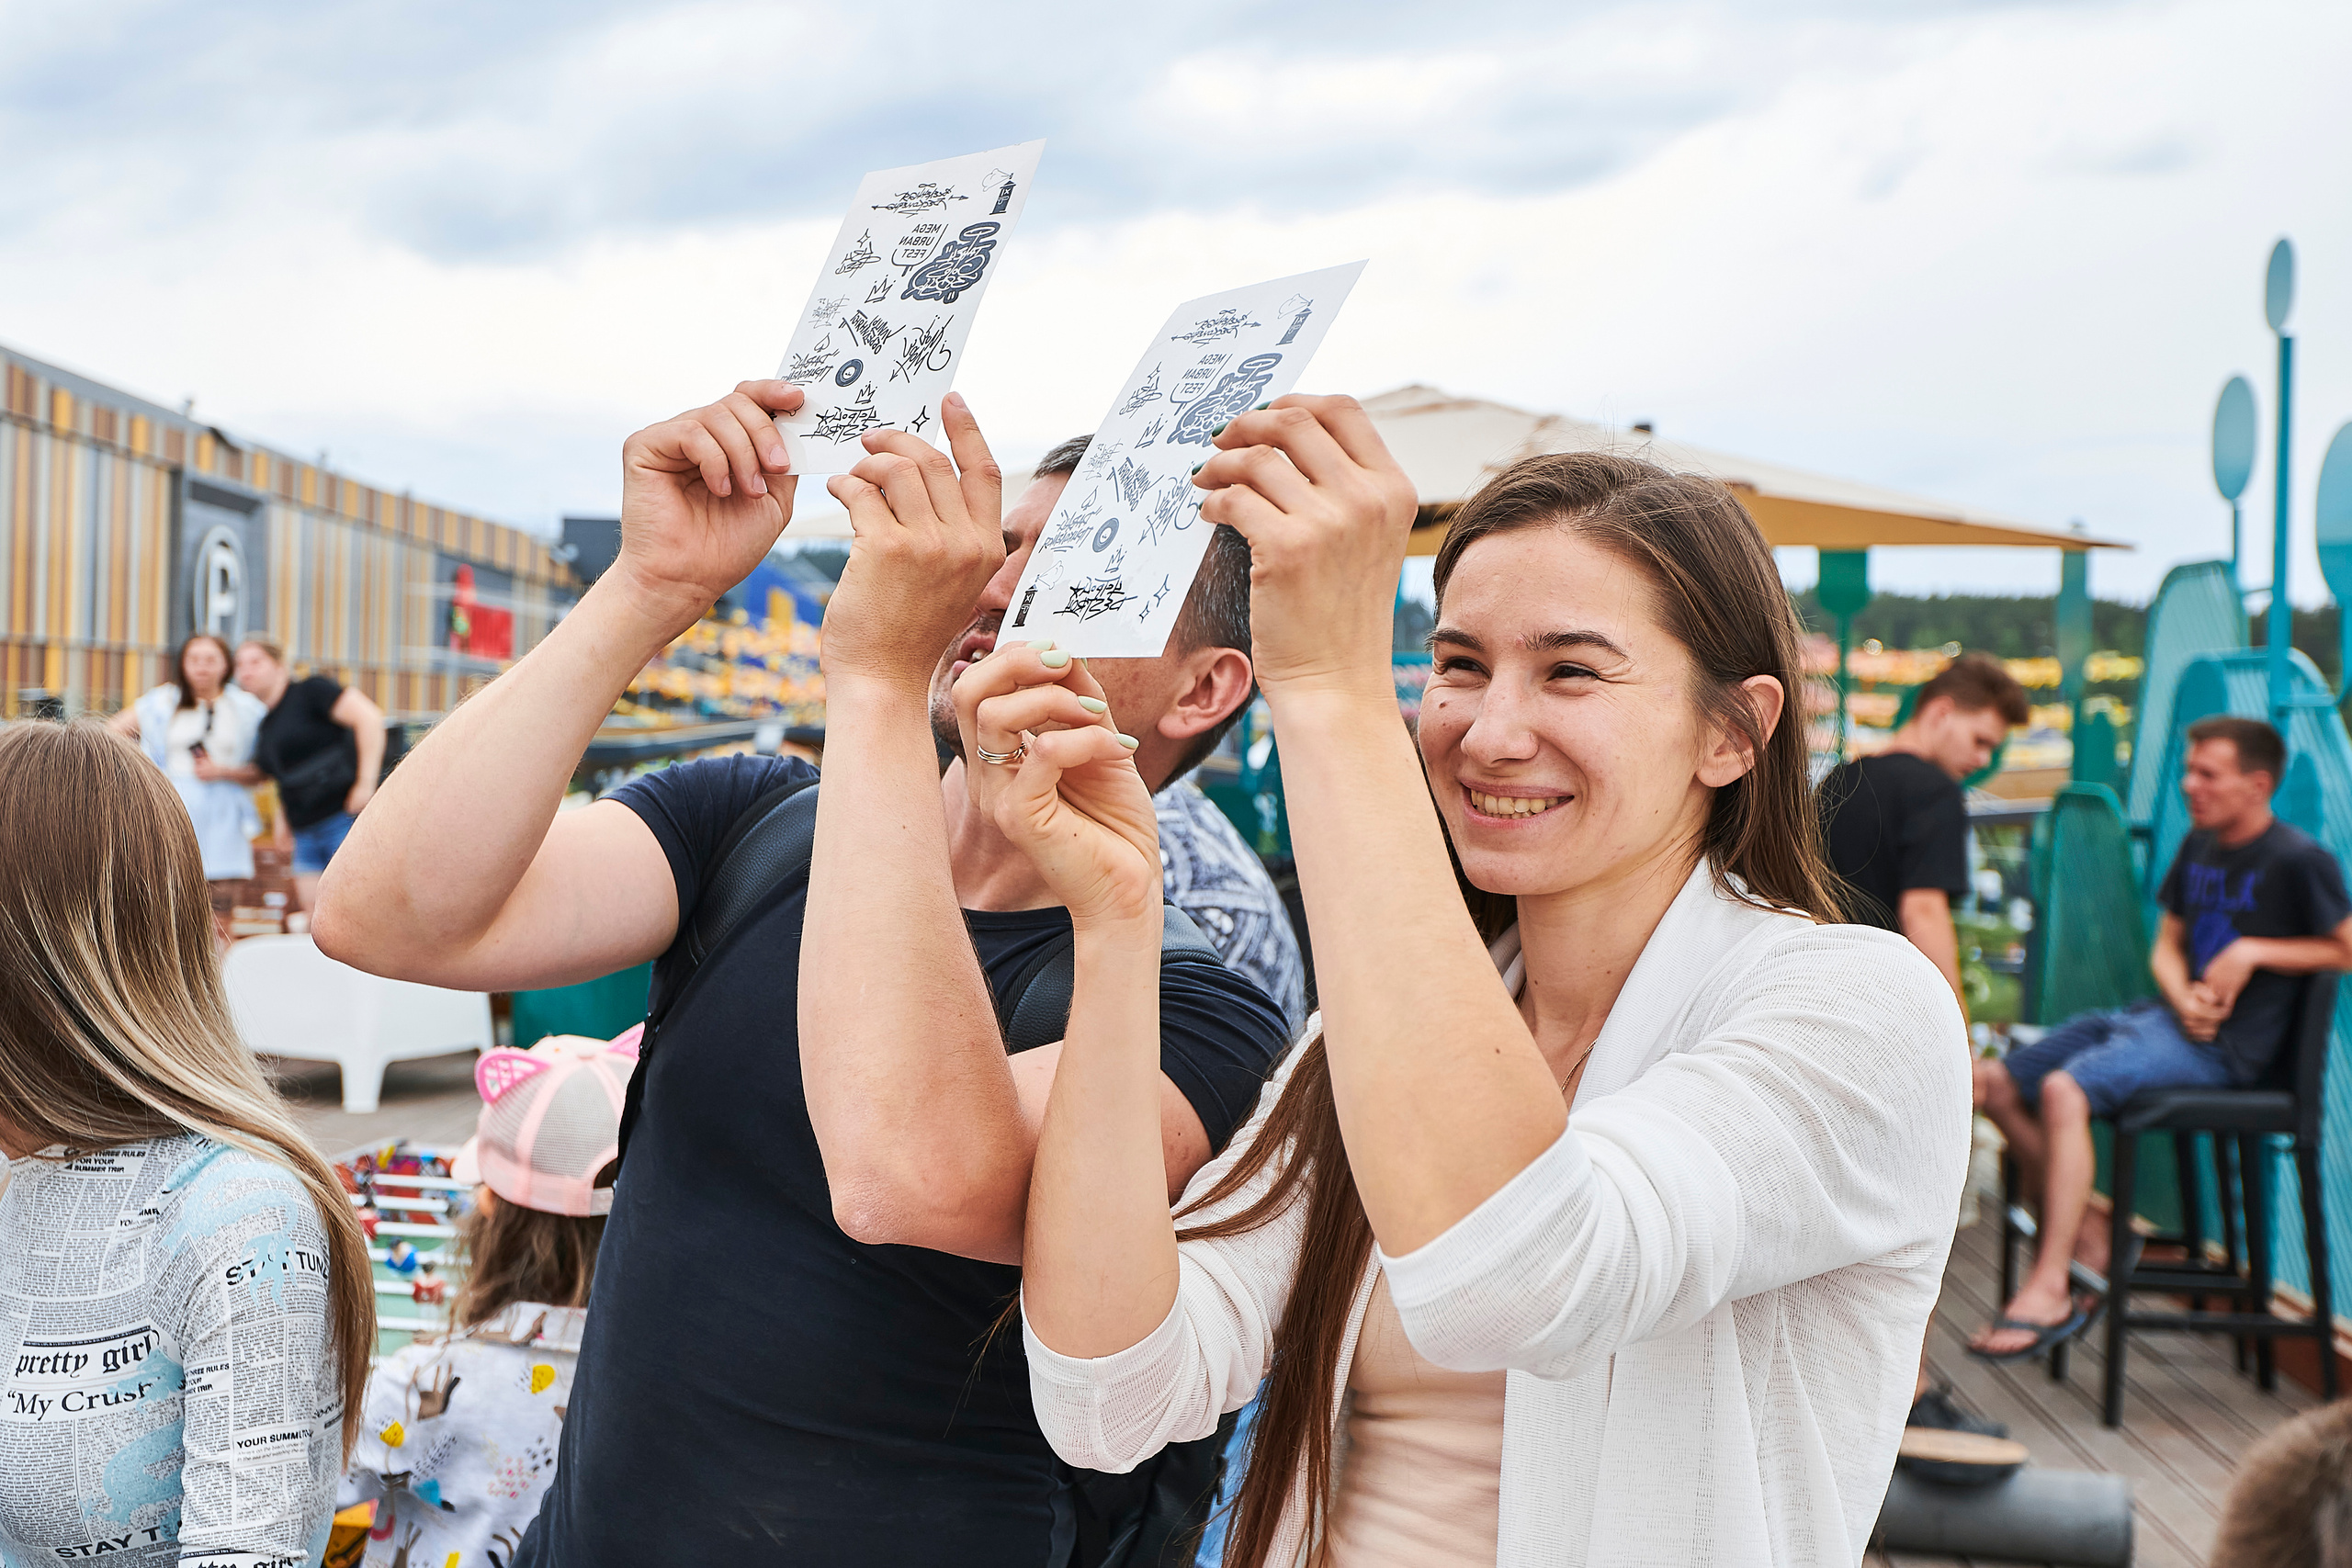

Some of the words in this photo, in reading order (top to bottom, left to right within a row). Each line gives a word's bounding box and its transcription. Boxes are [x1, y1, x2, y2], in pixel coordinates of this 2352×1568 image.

[15, 1350, 89, 1378] pretty
[102, 1334, 152, 1374] girl
[237, 1436, 267, 1449] YOUR
[55, 1534, 133, 1559] STAY
